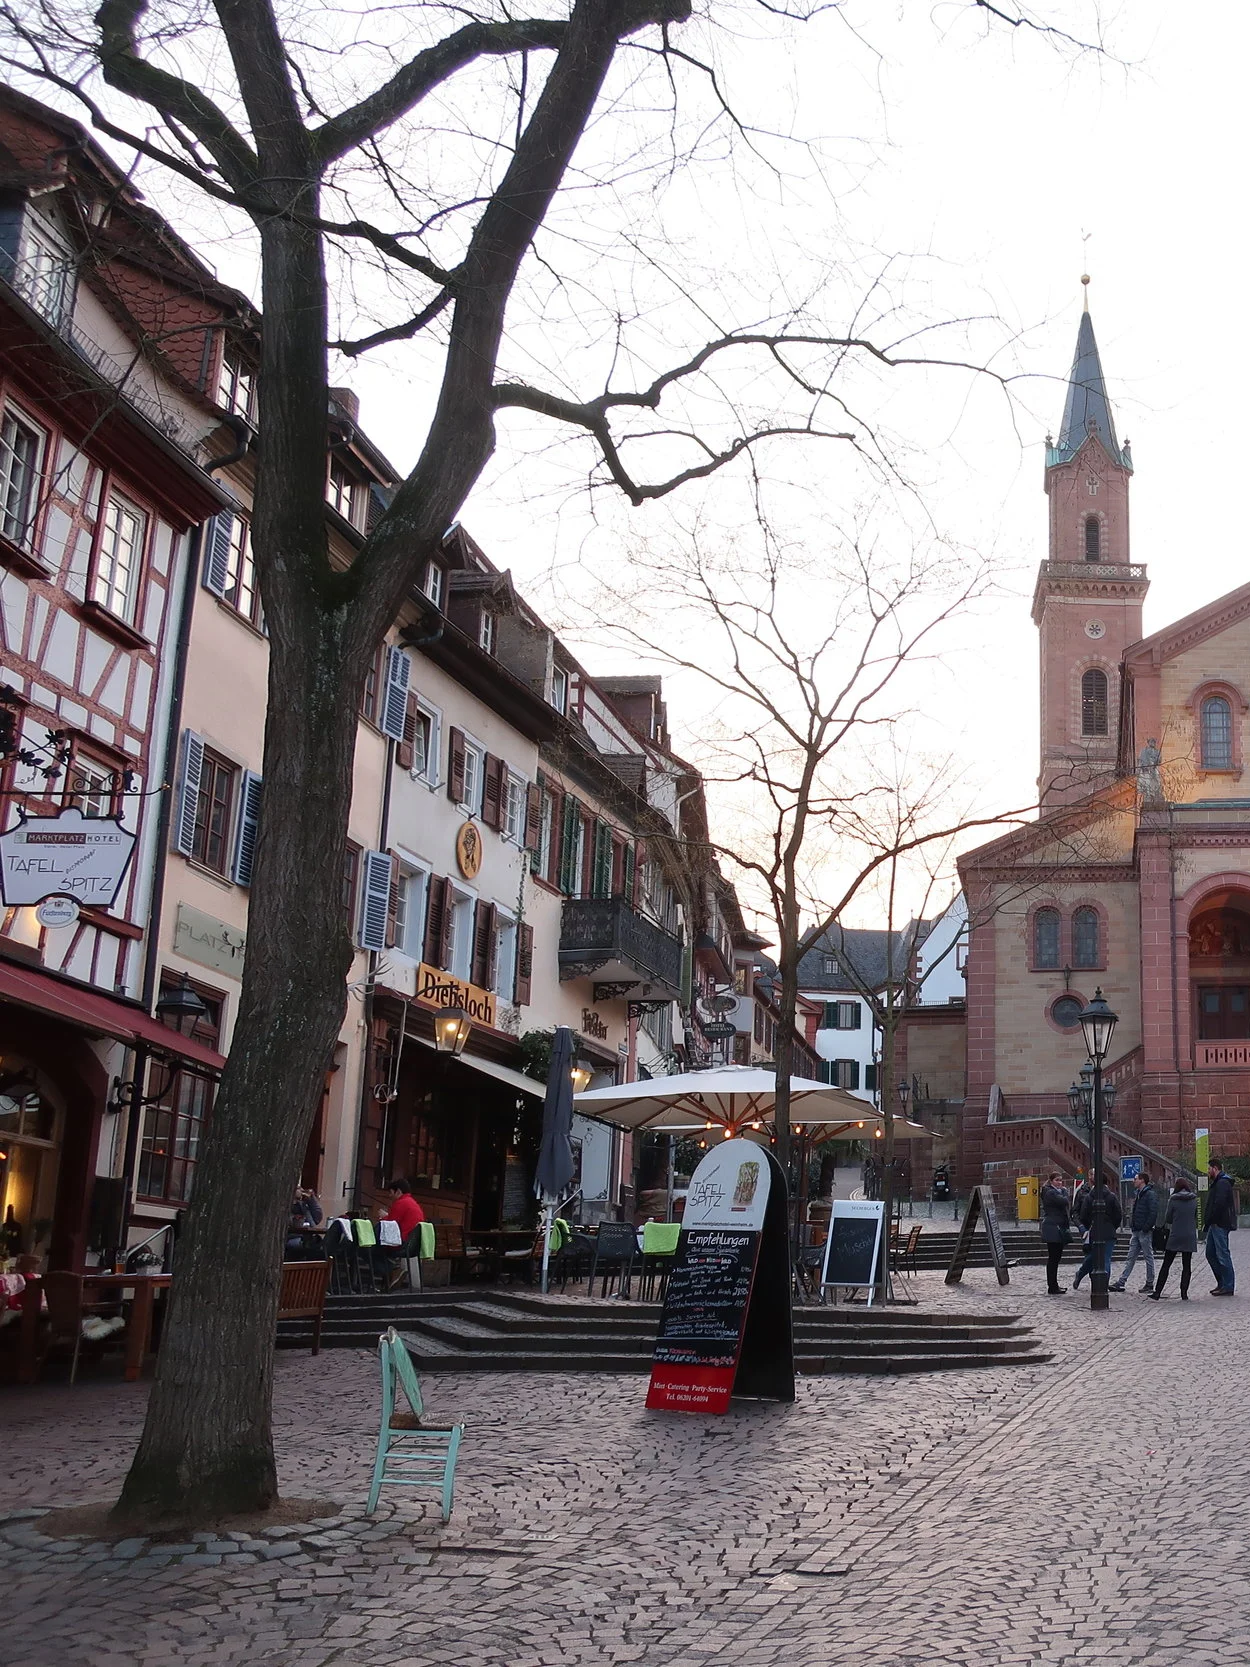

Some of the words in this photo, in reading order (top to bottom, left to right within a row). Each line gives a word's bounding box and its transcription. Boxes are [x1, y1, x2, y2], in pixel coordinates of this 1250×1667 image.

[27, 833, 85, 844] MARKTPLATZ
[87, 835, 119, 843] HOTEL
[7, 855, 64, 875] TAFEL
[58, 876, 112, 892] SPITZ
[423, 970, 493, 1025] Diebsloch
[694, 1182, 726, 1196] TAFEL
[689, 1195, 722, 1208] SPITZ
[687, 1231, 750, 1248] Empfehlungen
